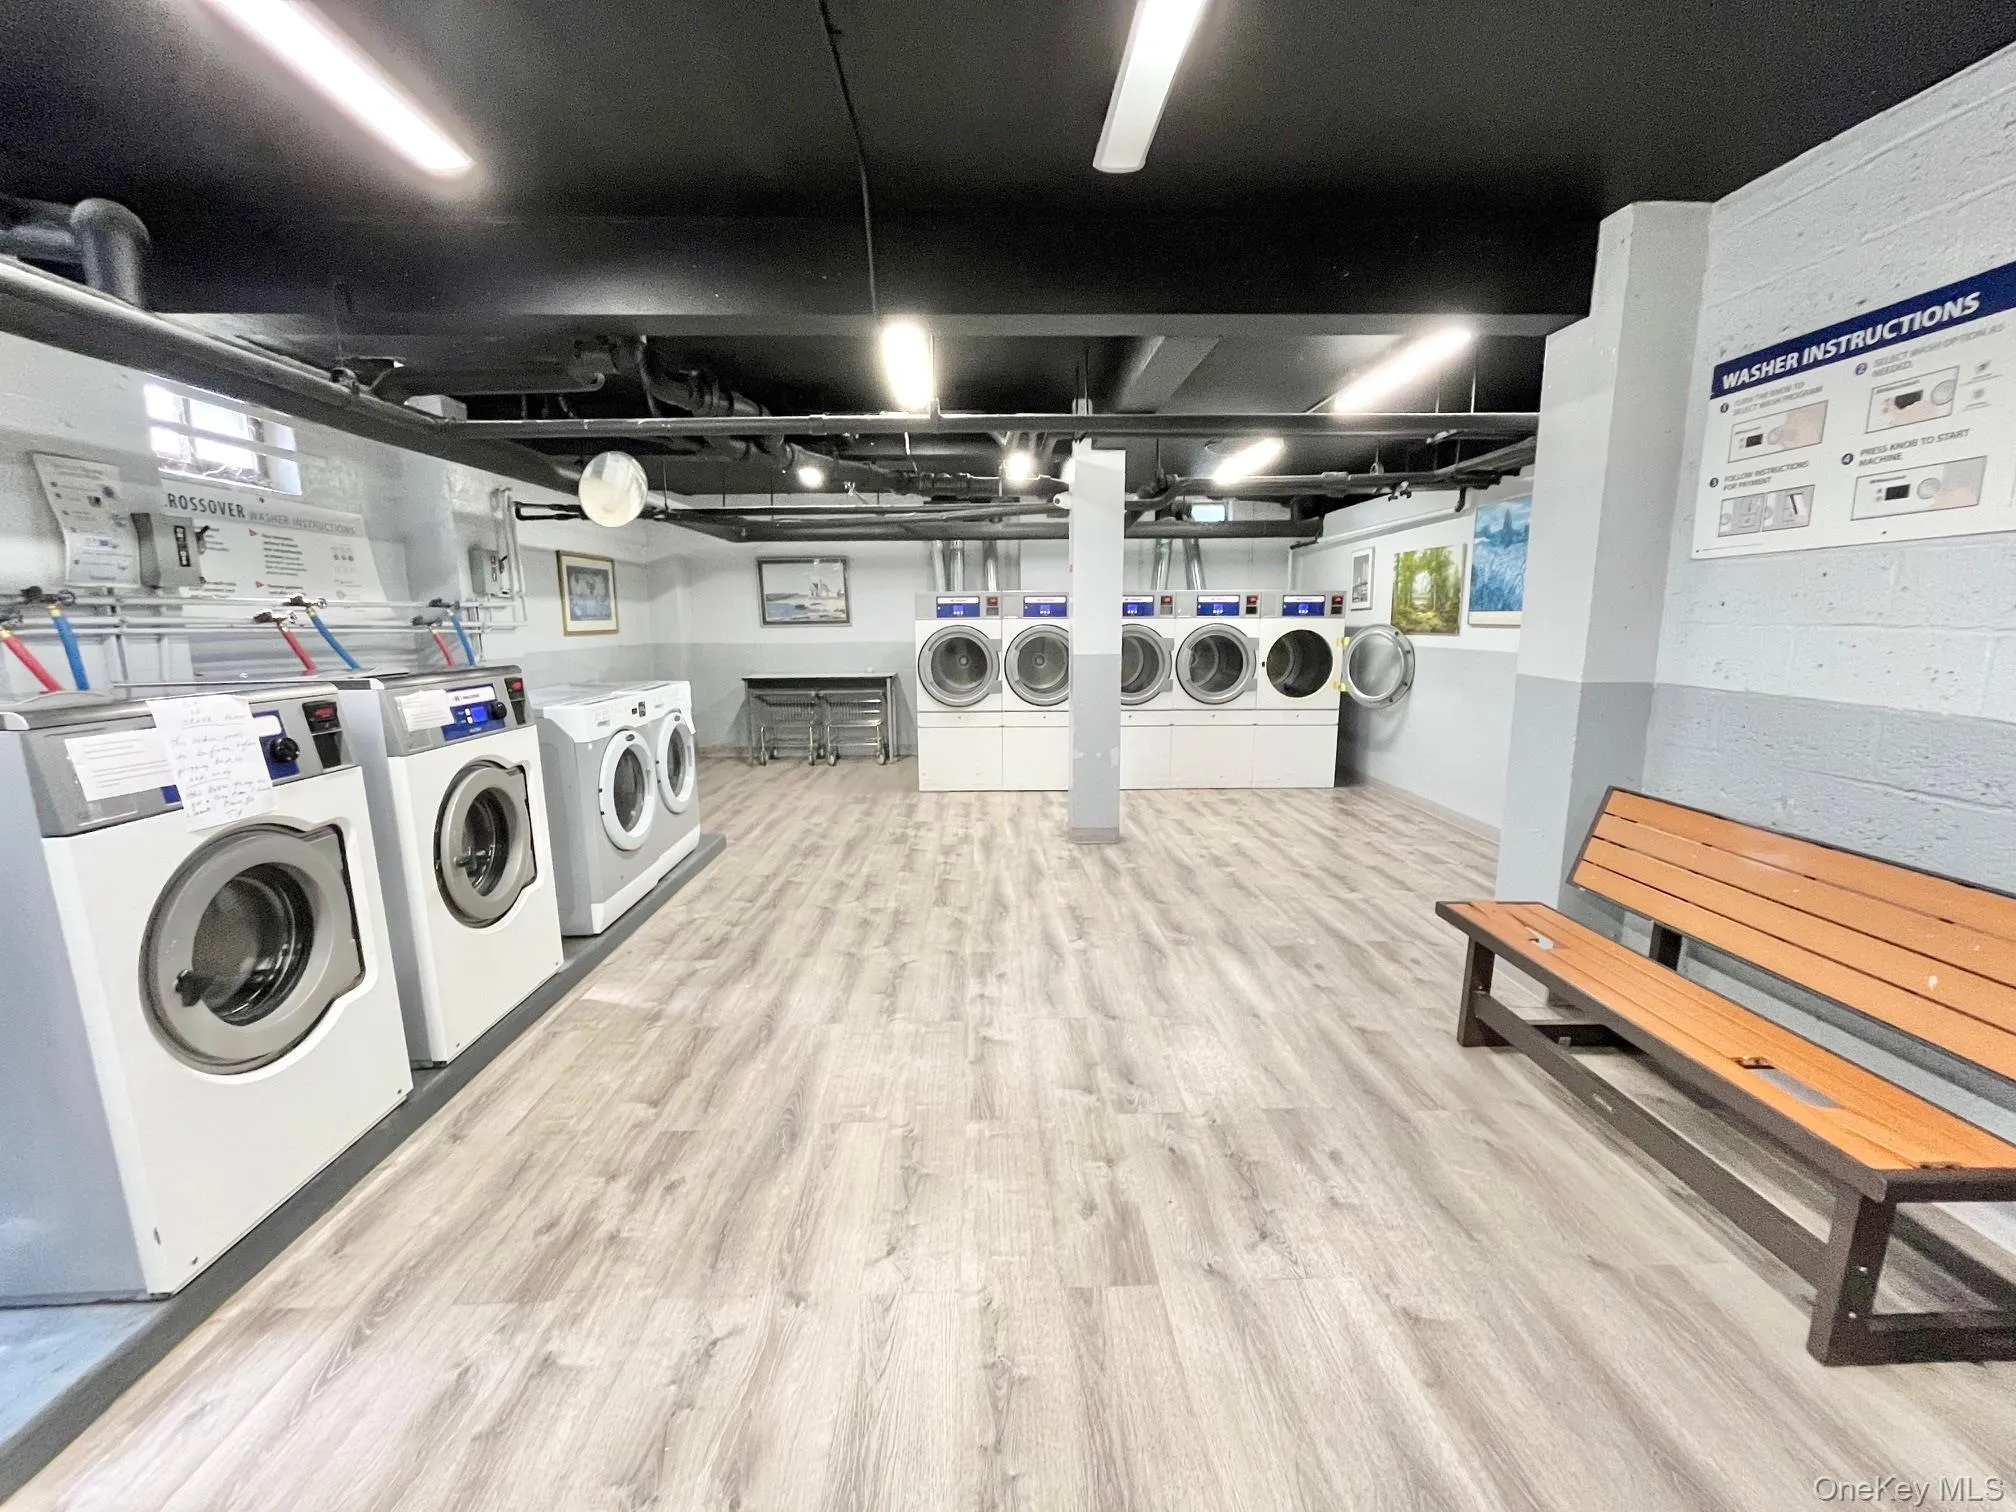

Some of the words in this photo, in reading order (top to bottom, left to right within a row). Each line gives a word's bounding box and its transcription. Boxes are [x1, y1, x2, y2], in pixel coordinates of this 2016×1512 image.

[1722, 352, 1799, 389] WASHER
[1802, 291, 1981, 364] INSTRUCTIONS
[1873, 351, 1909, 367] SELECT
[1860, 445, 1888, 456] PRESS
[1889, 439, 1918, 451] KNOB
[1920, 436, 1935, 445] TO
[1936, 429, 1970, 443] START
[1724, 471, 1753, 482] FOLLOW
[1754, 460, 1809, 477] INSTRUCTIONS
[1859, 452, 1903, 468] MACHINE
[1723, 482, 1737, 491] FOR
[248, 511, 289, 525] WASHER
[291, 516, 357, 535] INSTRUCTIONS
